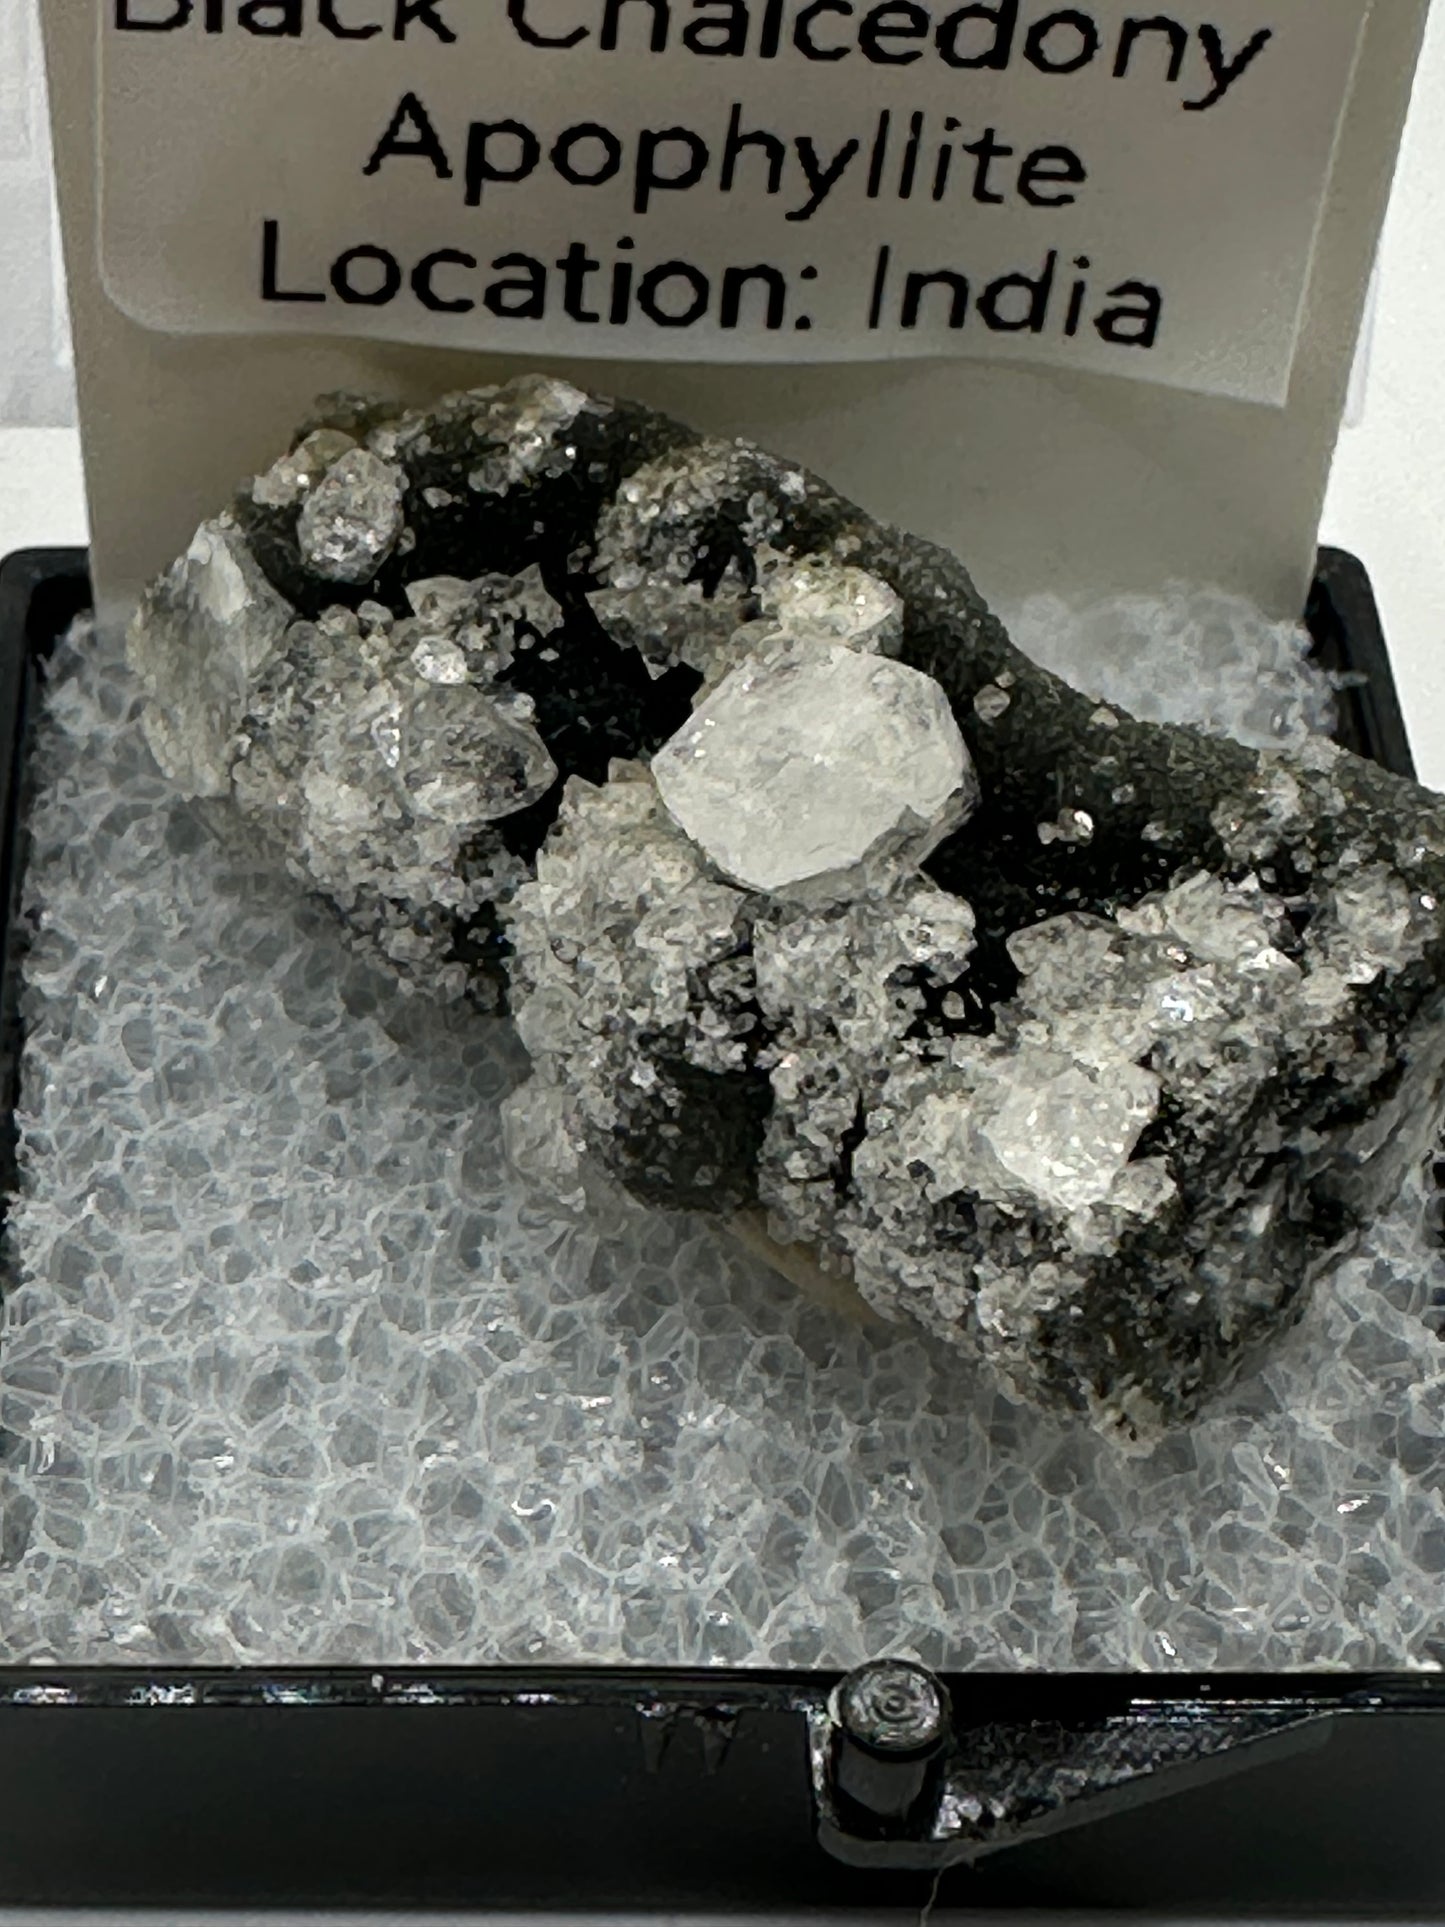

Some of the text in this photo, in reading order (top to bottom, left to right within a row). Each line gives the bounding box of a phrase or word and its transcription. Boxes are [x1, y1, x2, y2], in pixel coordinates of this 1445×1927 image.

[506, 0, 1274, 112] Chalcedony
[362, 91, 1089, 223] Apophyllite
[260, 218, 1164, 350] Location: India
